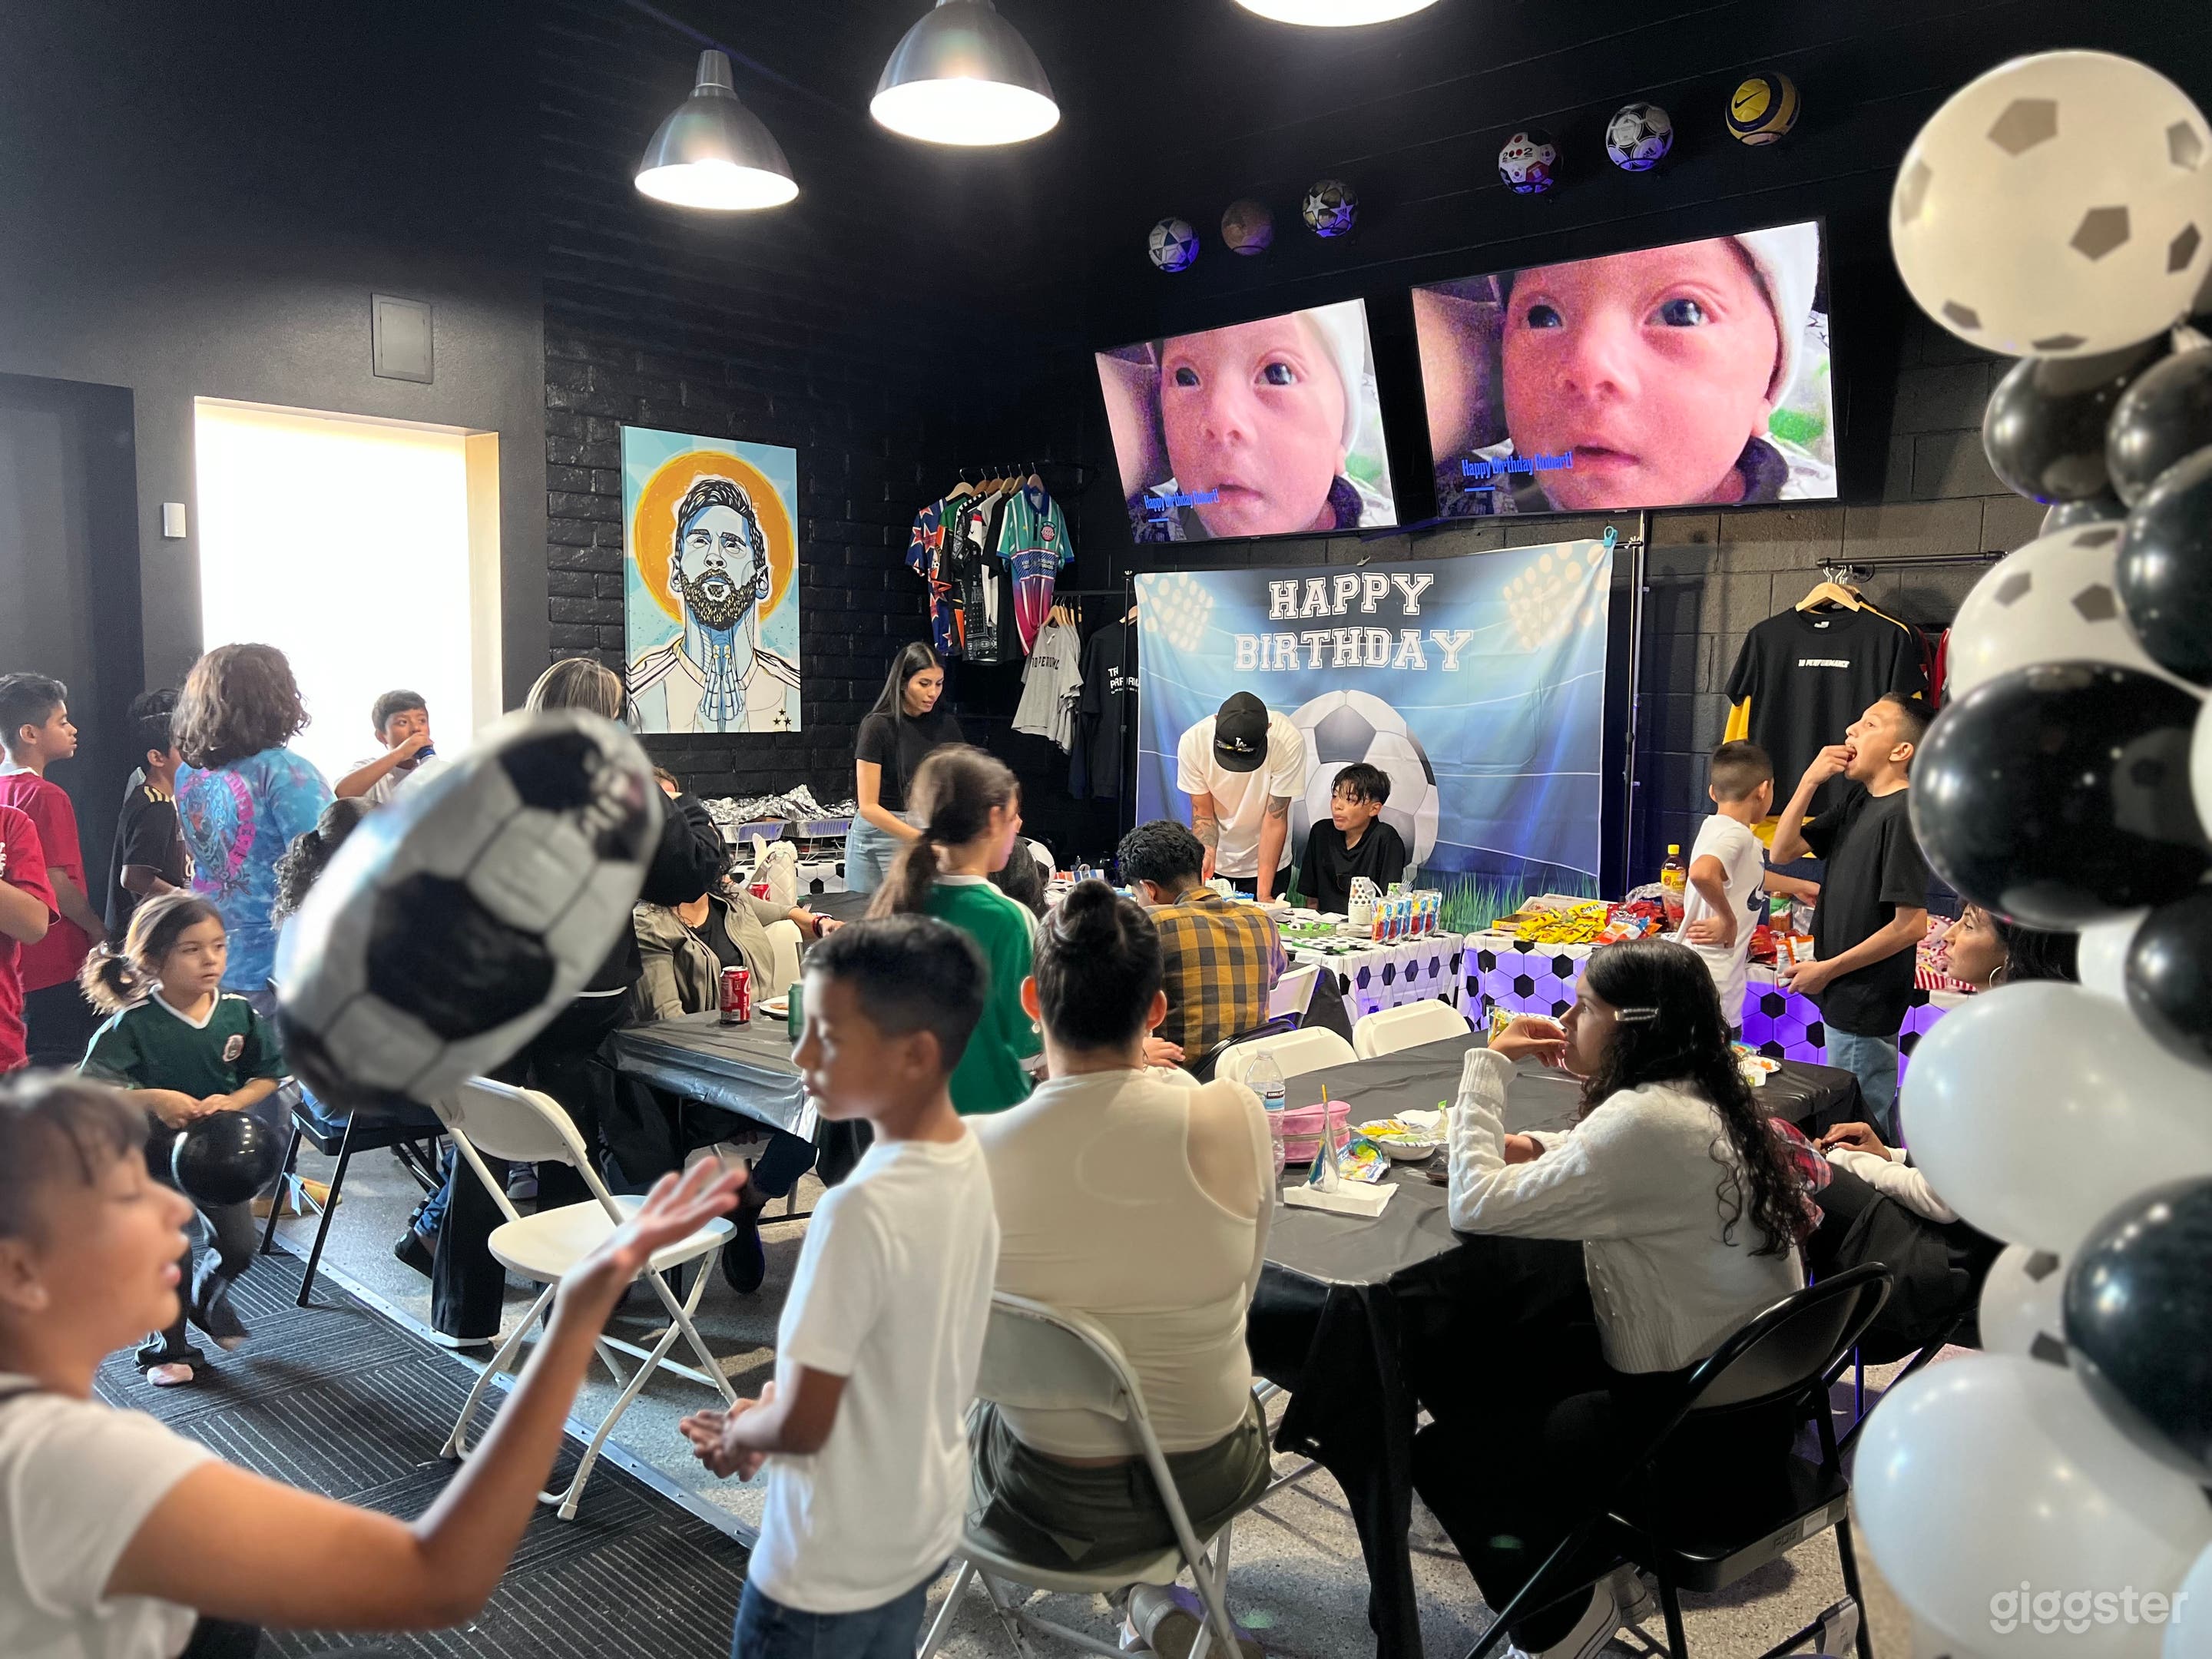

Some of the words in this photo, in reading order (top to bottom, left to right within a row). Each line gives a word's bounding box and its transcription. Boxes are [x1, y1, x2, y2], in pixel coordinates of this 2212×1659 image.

[1462, 459, 1491, 479] Happy
[1491, 455, 1533, 476] Birthday
[1144, 495, 1165, 512] Happy
[1164, 492, 1193, 508] Birthday
[1269, 572, 1434, 620] HAPPY
[1233, 626, 1474, 671] BIRTHDAY
